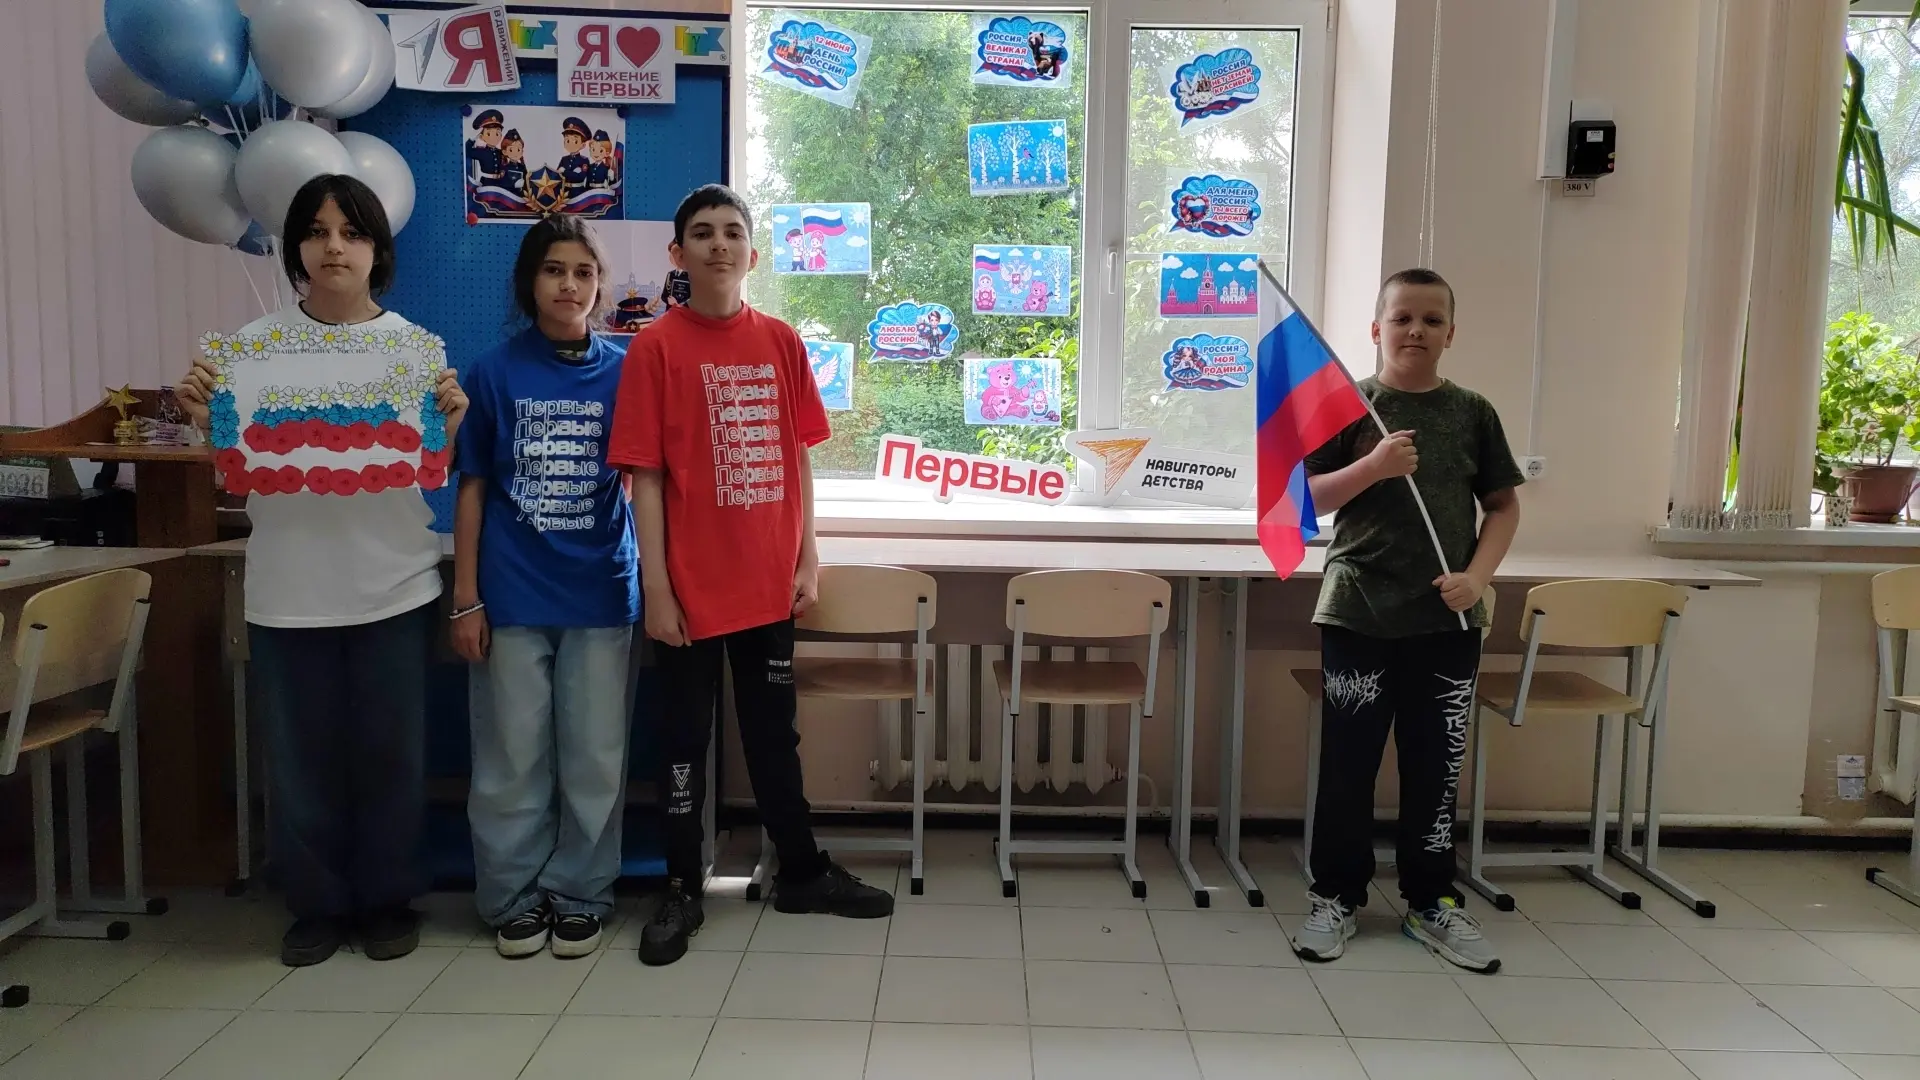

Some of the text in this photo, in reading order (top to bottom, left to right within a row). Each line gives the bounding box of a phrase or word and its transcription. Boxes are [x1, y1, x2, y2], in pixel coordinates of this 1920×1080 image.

[443, 11, 503, 85] Я
[576, 24, 609, 67] Я
[825, 39, 851, 53] ИЮНЯ
[988, 33, 1022, 43] РОССИЯ
[495, 18, 516, 82] ДВИЖЕНИИ
[813, 49, 841, 63] ДЕНЬ
[986, 44, 1027, 55] ВЕЛИКАЯ
[804, 55, 845, 76] РОССИИ!
[986, 55, 1024, 66] СТРАНА!
[570, 70, 660, 83] ДВИЖЕНИЕ
[570, 81, 662, 98] ПЕРВЫХ
[1566, 184, 1581, 192] 380
[700, 363, 776, 384] Первые
[1204, 366, 1246, 375] РОДИНА!
[705, 383, 779, 405] Первые
[515, 398, 604, 419] Первые
[708, 404, 780, 426] Первые
[515, 418, 603, 441] Первые
[513, 438, 599, 460] Первые
[713, 444, 783, 468] Первые
[515, 458, 599, 480] Первые
[715, 465, 784, 488] Первые
[881, 440, 1065, 500] Первые
[1145, 458, 1237, 479] НАВИГАТОРЫ
[511, 477, 597, 500] Первые
[1141, 474, 1204, 491] ДЕТСТВА
[717, 485, 784, 510] Первые
[672, 790, 690, 798] POWER
